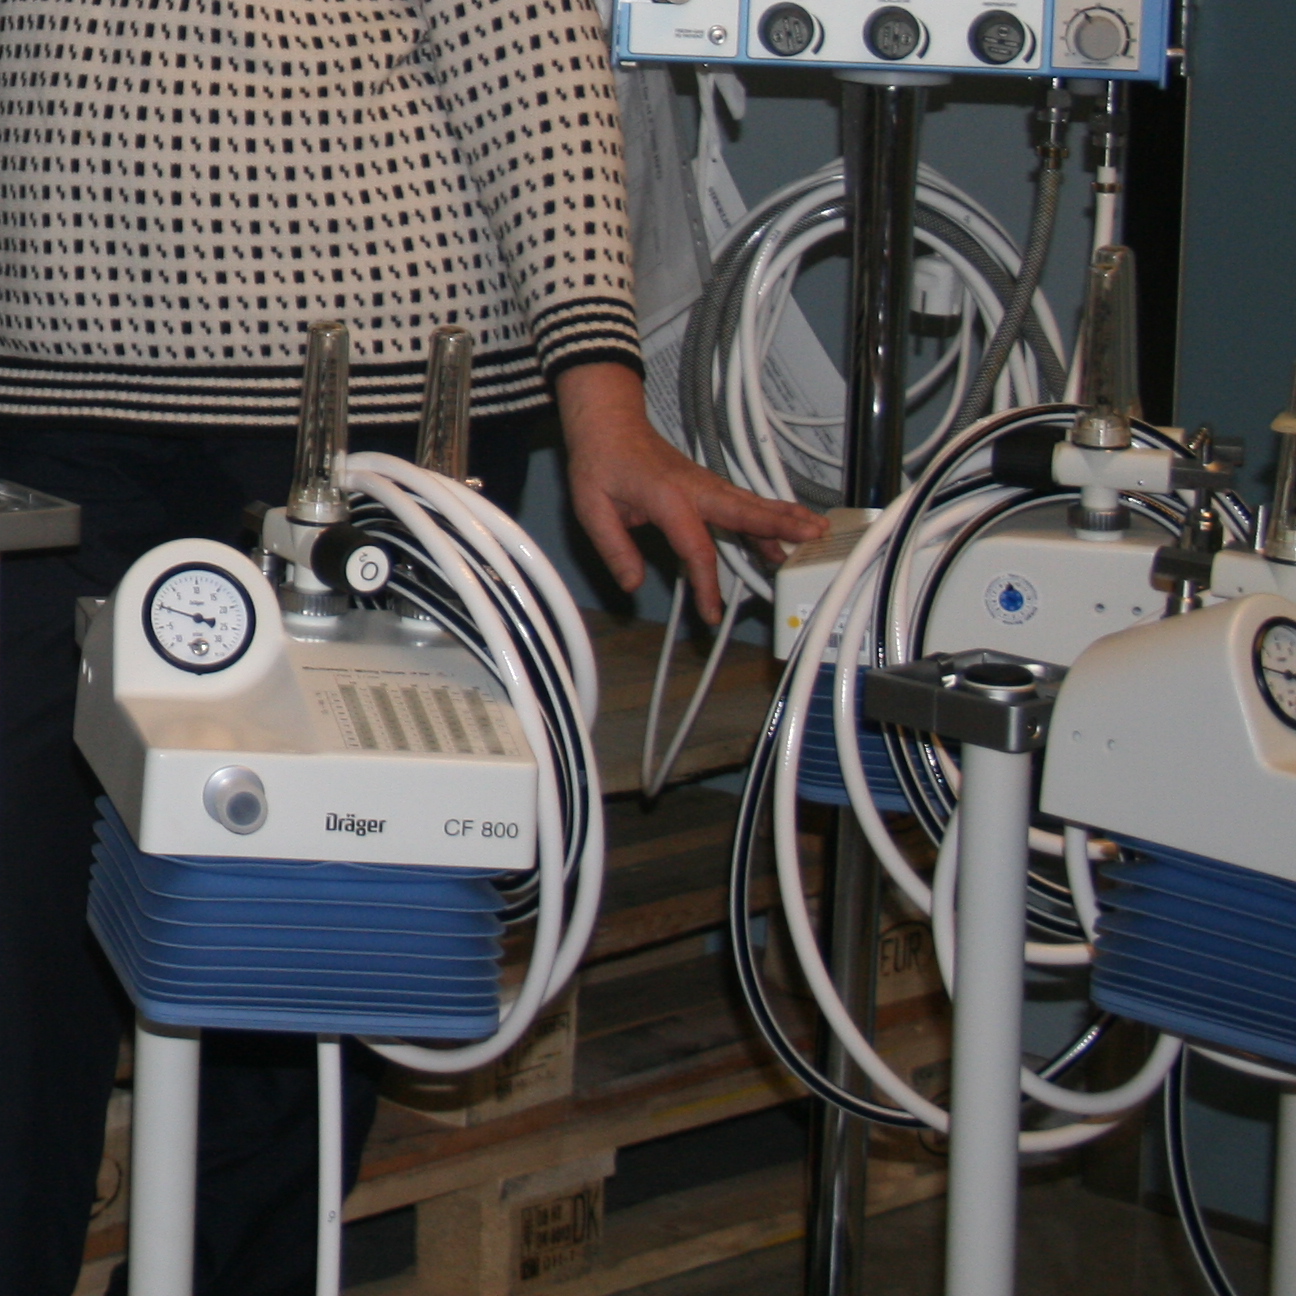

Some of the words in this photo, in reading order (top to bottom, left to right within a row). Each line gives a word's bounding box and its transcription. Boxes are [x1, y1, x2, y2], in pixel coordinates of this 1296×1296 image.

[325, 812, 387, 837] Dräger
[443, 817, 475, 840] CF
[481, 818, 519, 841] 800
[879, 928, 923, 981] EUR
